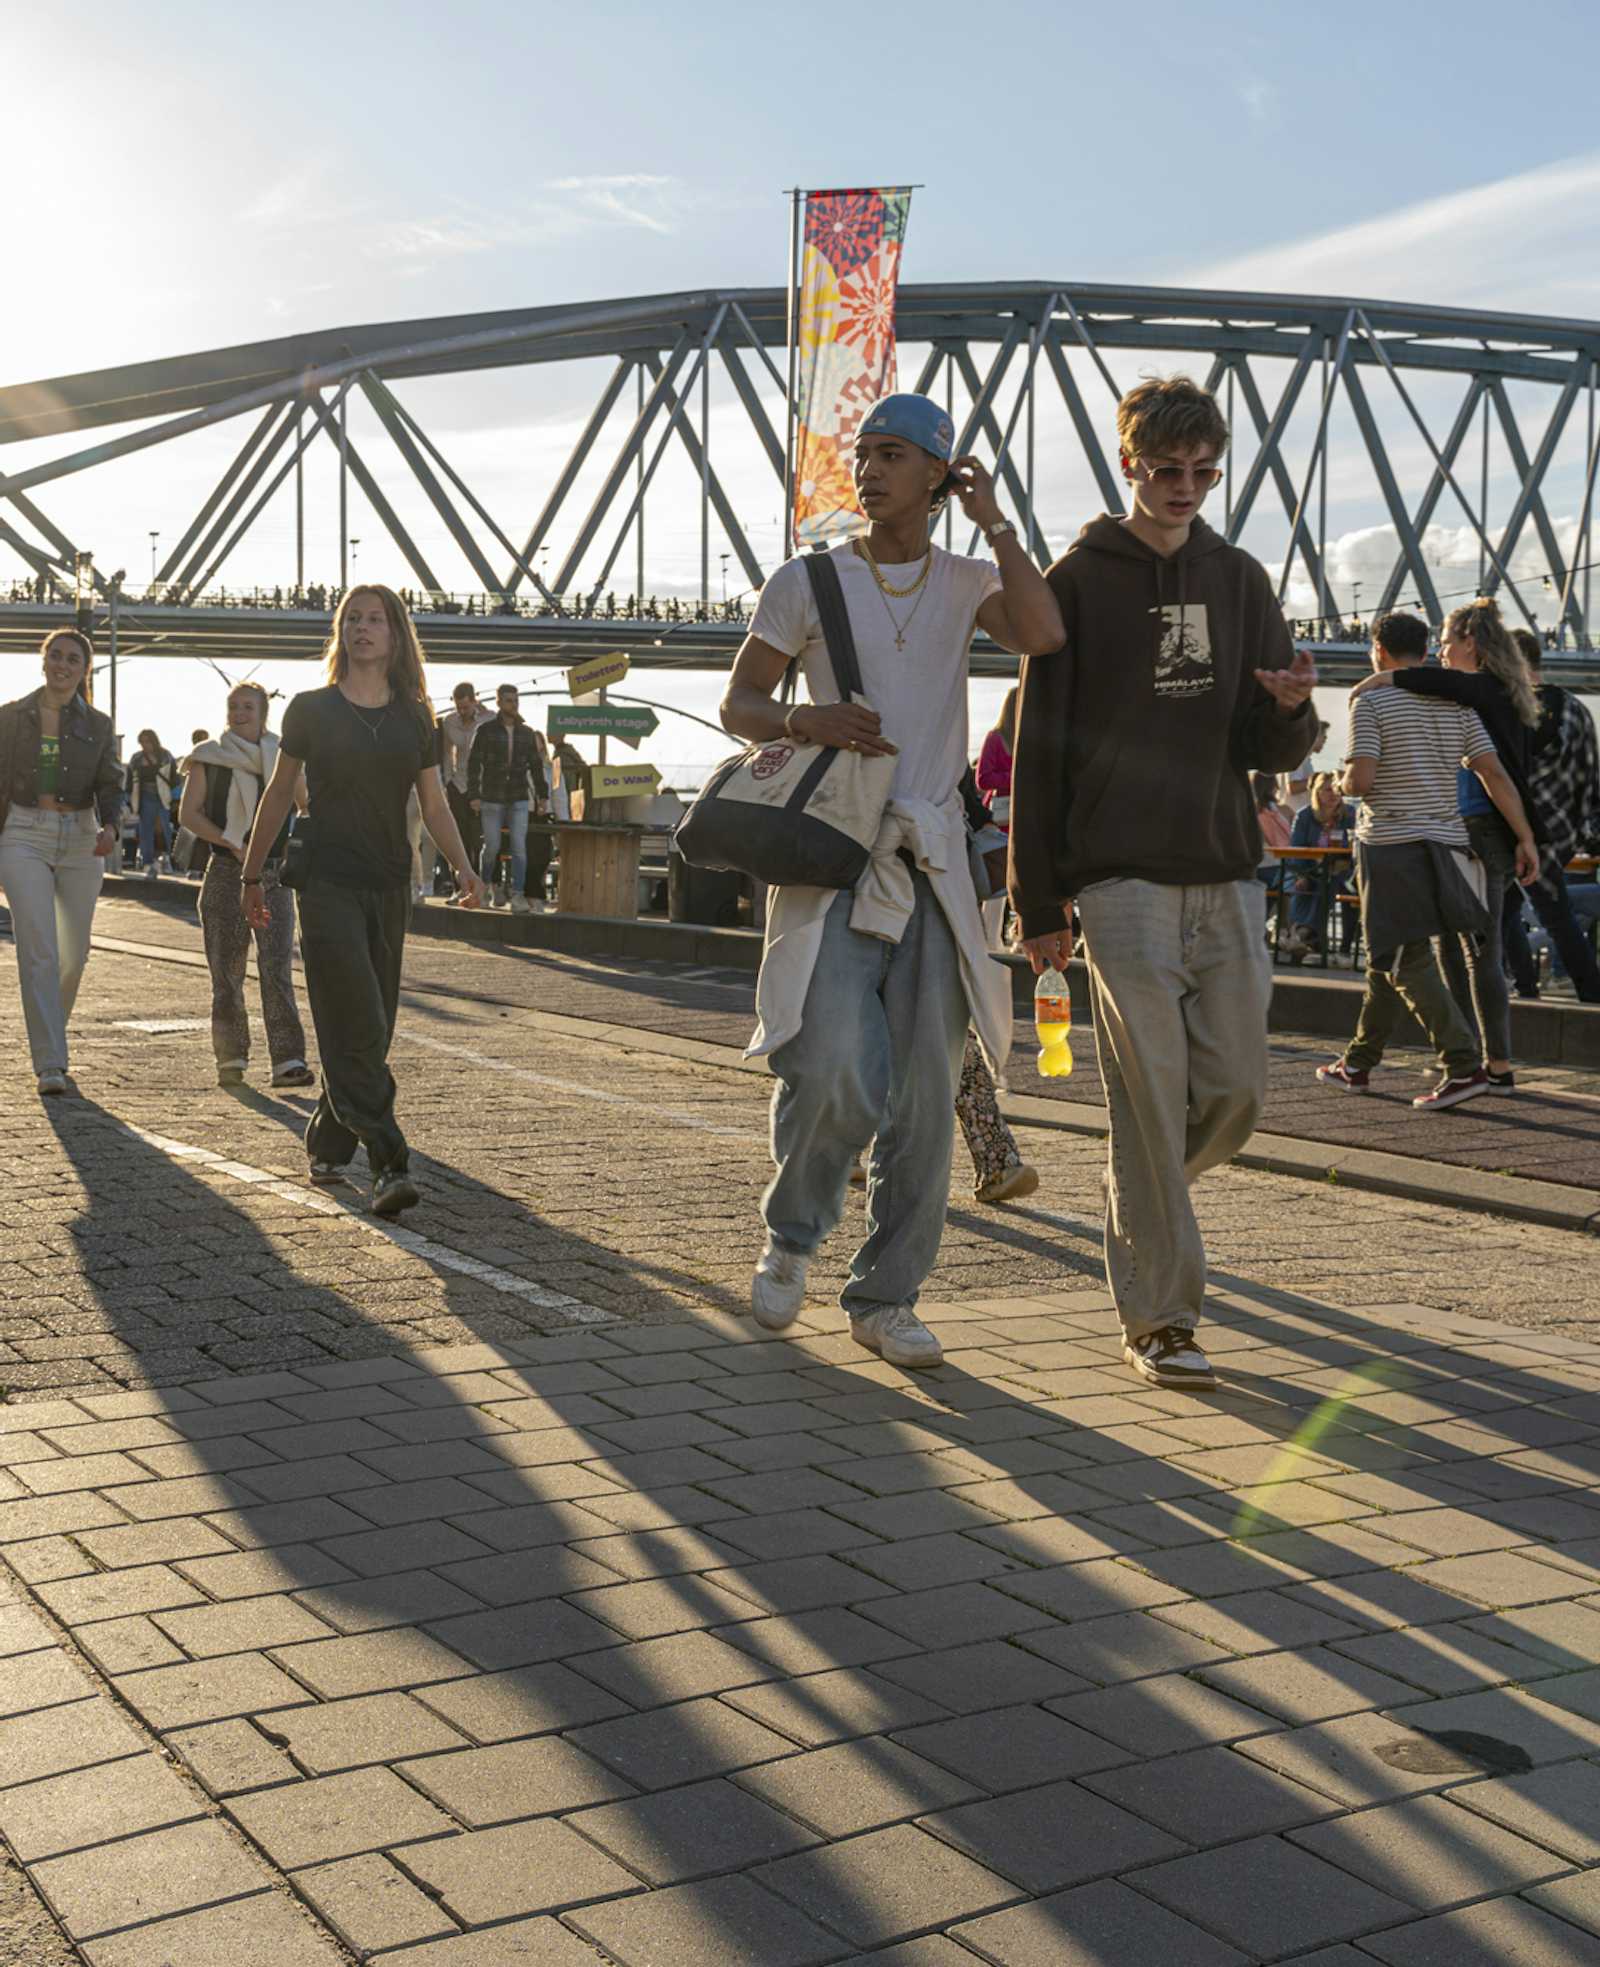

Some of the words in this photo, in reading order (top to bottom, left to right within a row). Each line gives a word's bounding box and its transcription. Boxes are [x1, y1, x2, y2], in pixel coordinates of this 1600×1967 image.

[576, 662, 625, 684] Toiletten
[556, 715, 612, 727] Labyrinth
[615, 718, 649, 730] stage
[603, 777, 619, 786] De
[623, 775, 653, 785] Waal
